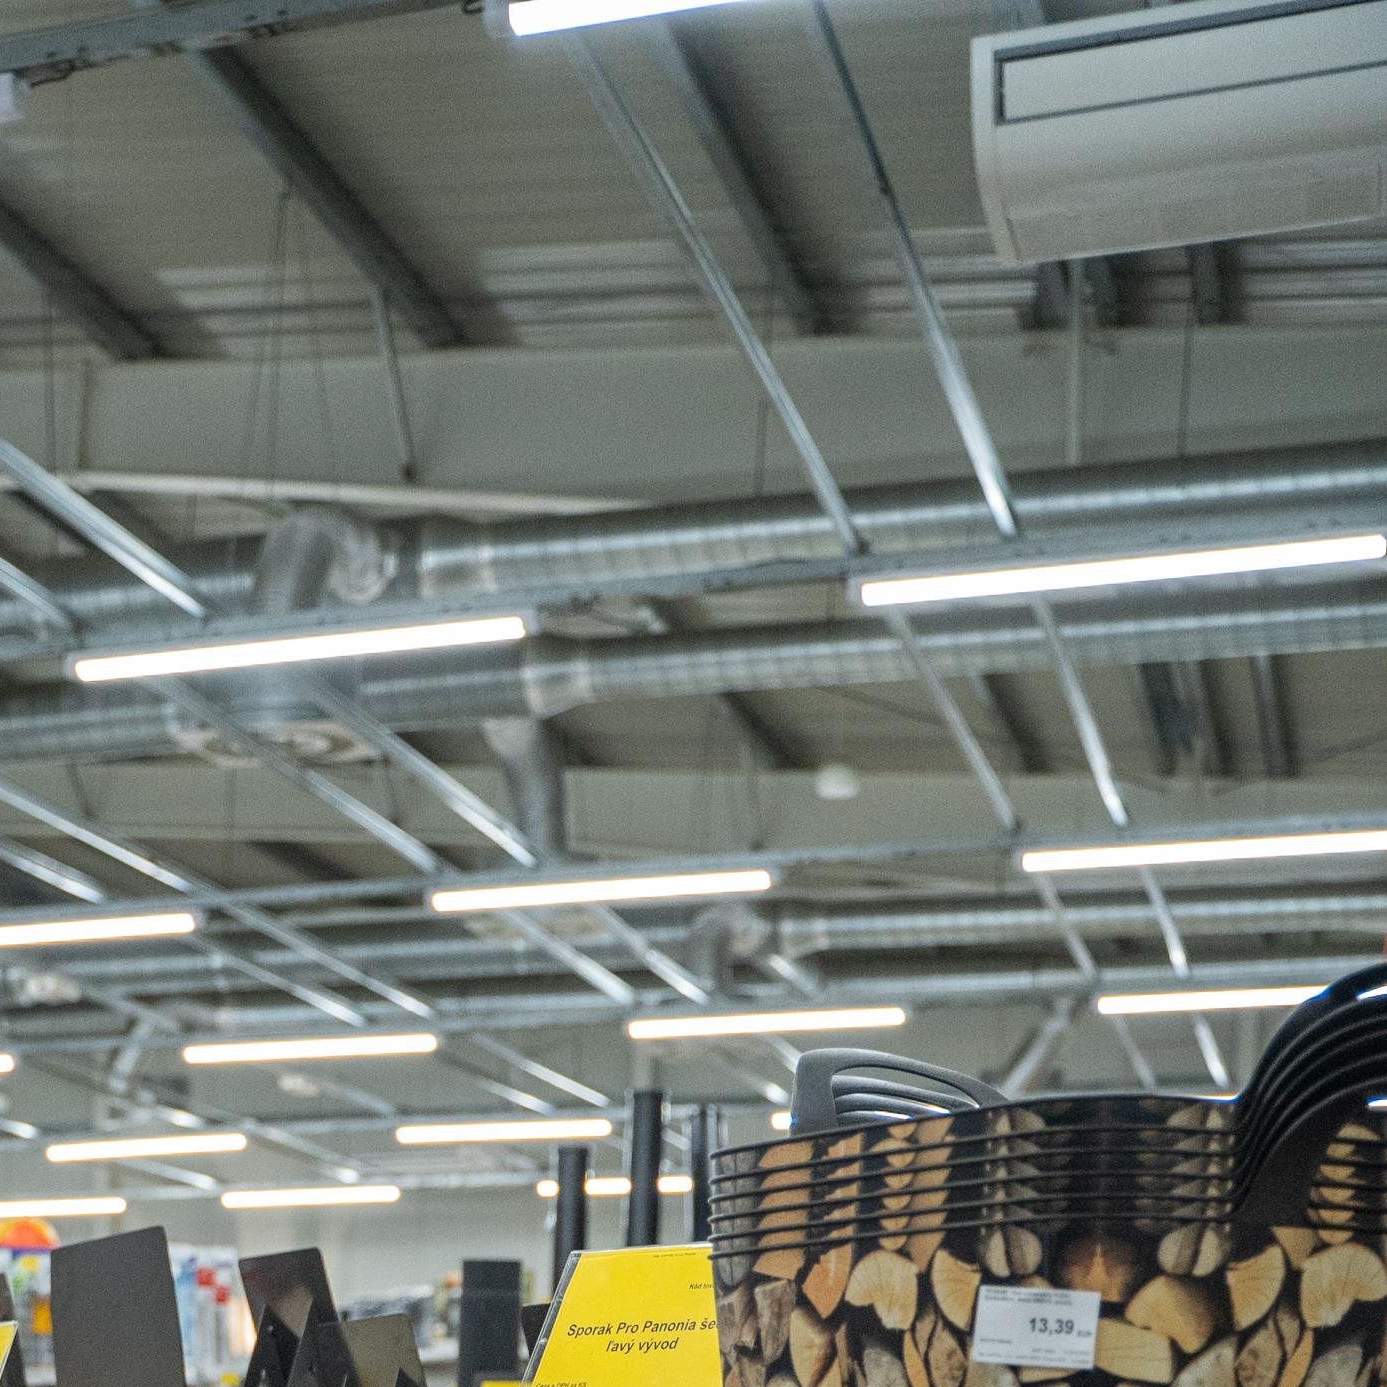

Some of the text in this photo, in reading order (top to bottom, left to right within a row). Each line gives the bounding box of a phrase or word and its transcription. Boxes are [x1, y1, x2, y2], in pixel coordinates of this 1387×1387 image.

[567, 1323, 612, 1339] Sporak
[616, 1322, 639, 1335] Pro
[642, 1319, 696, 1333] Panonia
[1029, 1317, 1075, 1337] 13,39
[638, 1337, 679, 1354] vývod
